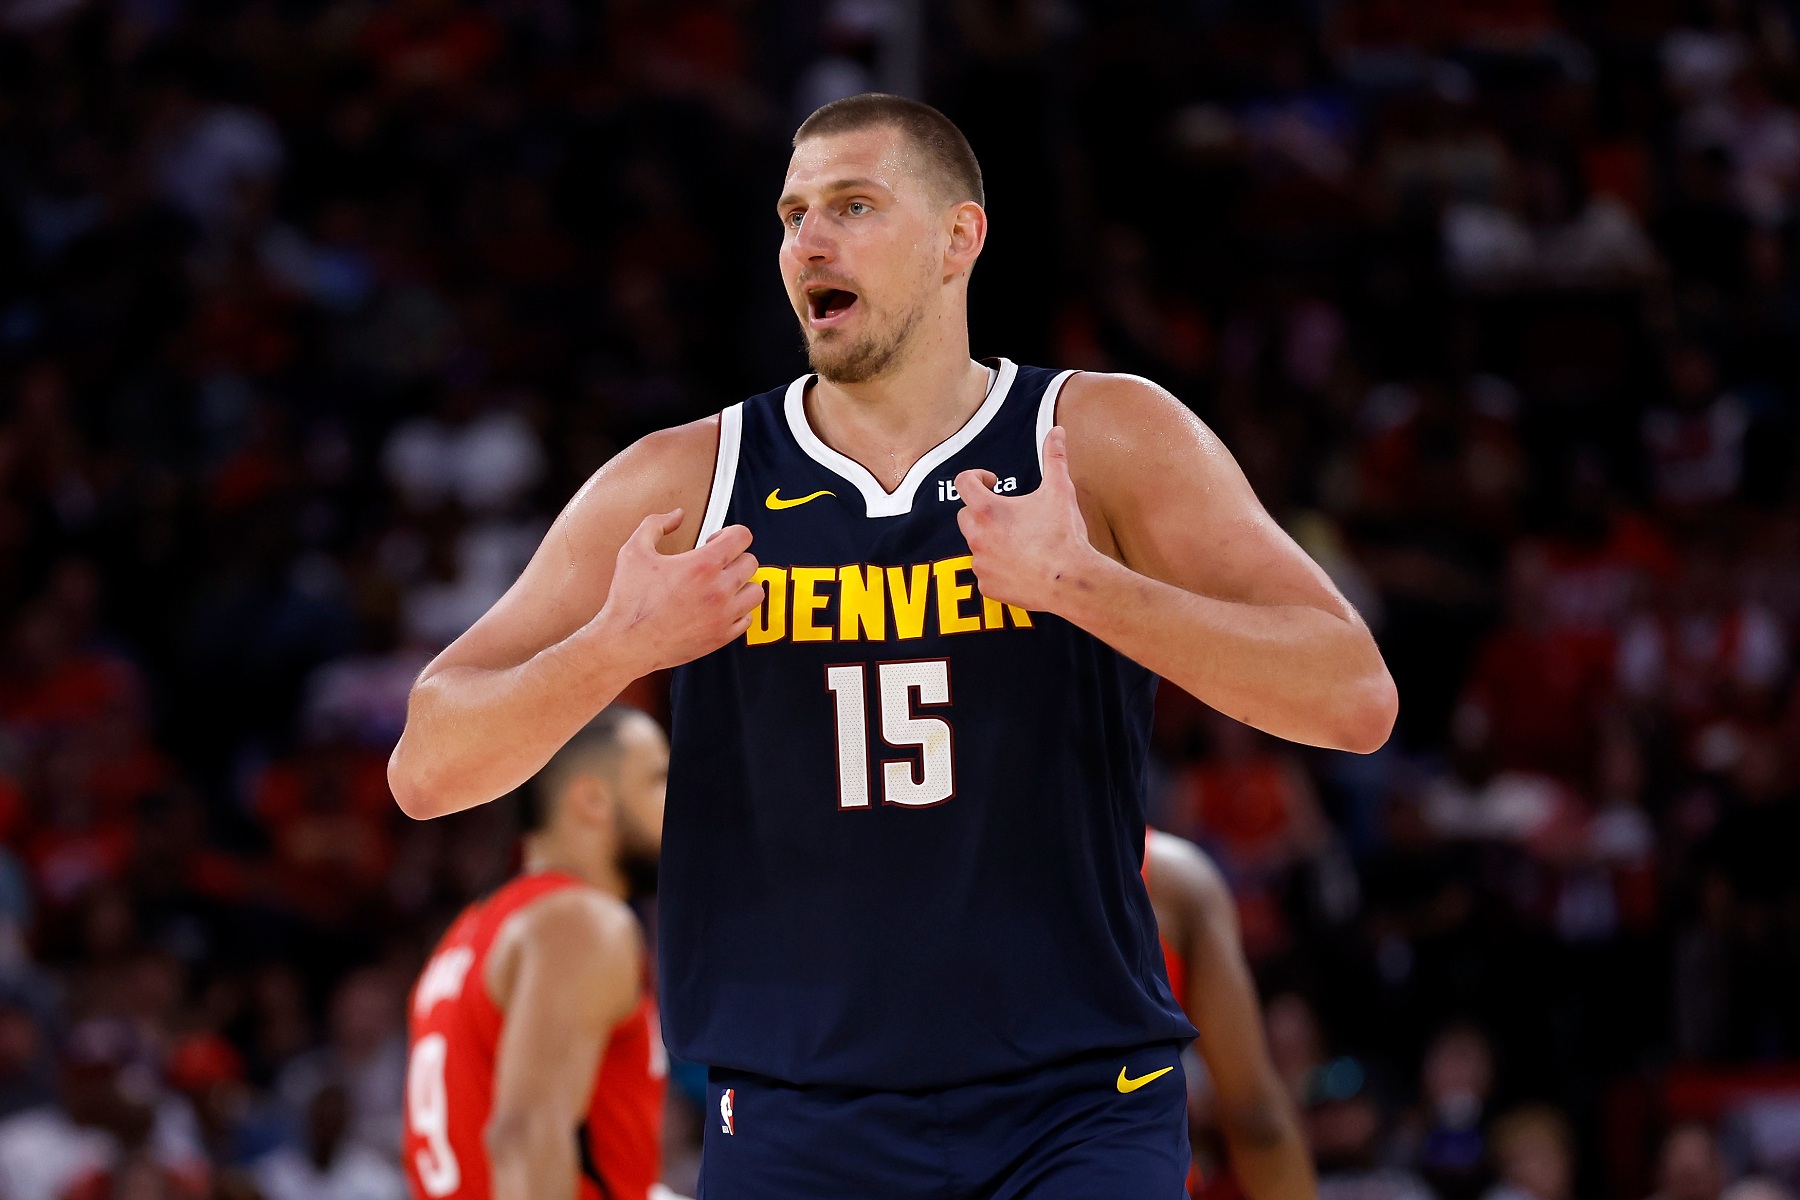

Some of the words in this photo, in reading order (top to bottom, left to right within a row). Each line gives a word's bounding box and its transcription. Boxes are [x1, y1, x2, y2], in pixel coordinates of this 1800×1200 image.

[938, 476, 1017, 502] ibta
[824, 657, 956, 811] 15
[408, 1032, 460, 1198] 9
